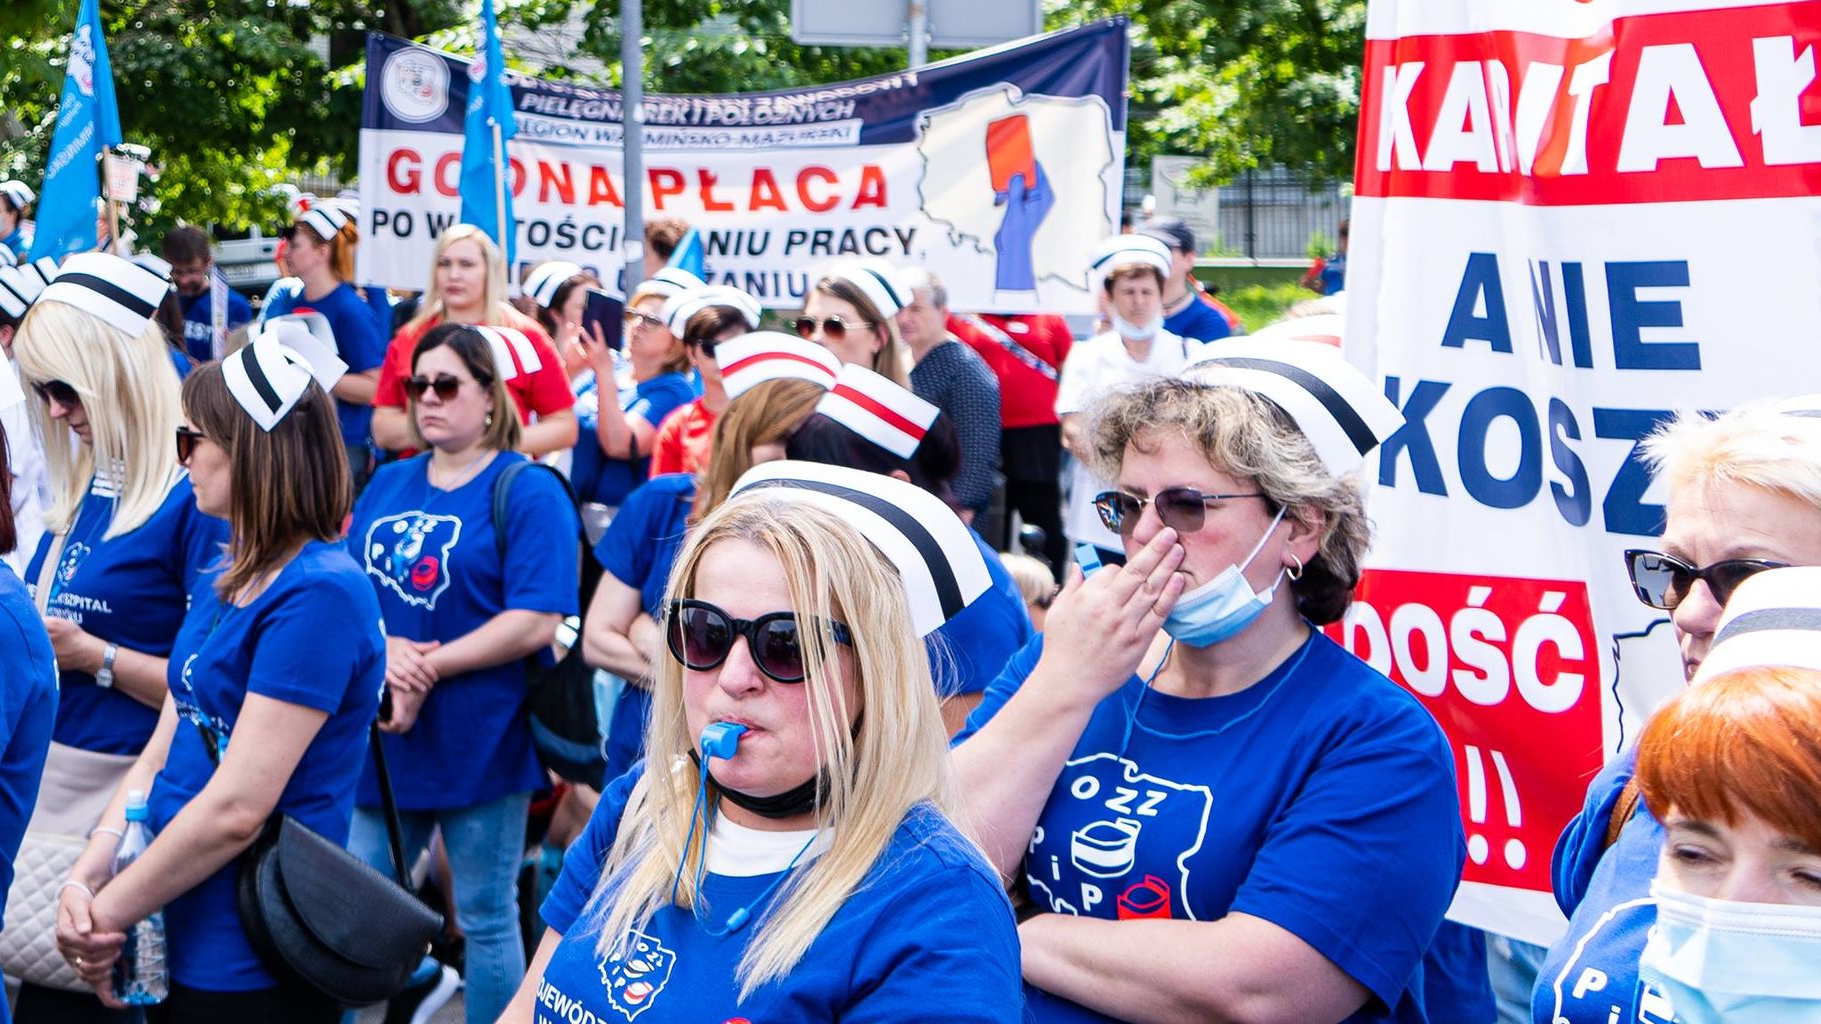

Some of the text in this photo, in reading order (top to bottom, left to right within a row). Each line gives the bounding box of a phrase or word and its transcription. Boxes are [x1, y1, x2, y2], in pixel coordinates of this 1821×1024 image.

[648, 165, 889, 212] PŁACA
[371, 209, 413, 238] PO
[1441, 252, 1702, 370] A NIE
[1379, 376, 1680, 538] KOSZ
[1071, 776, 1168, 816] OZZ
